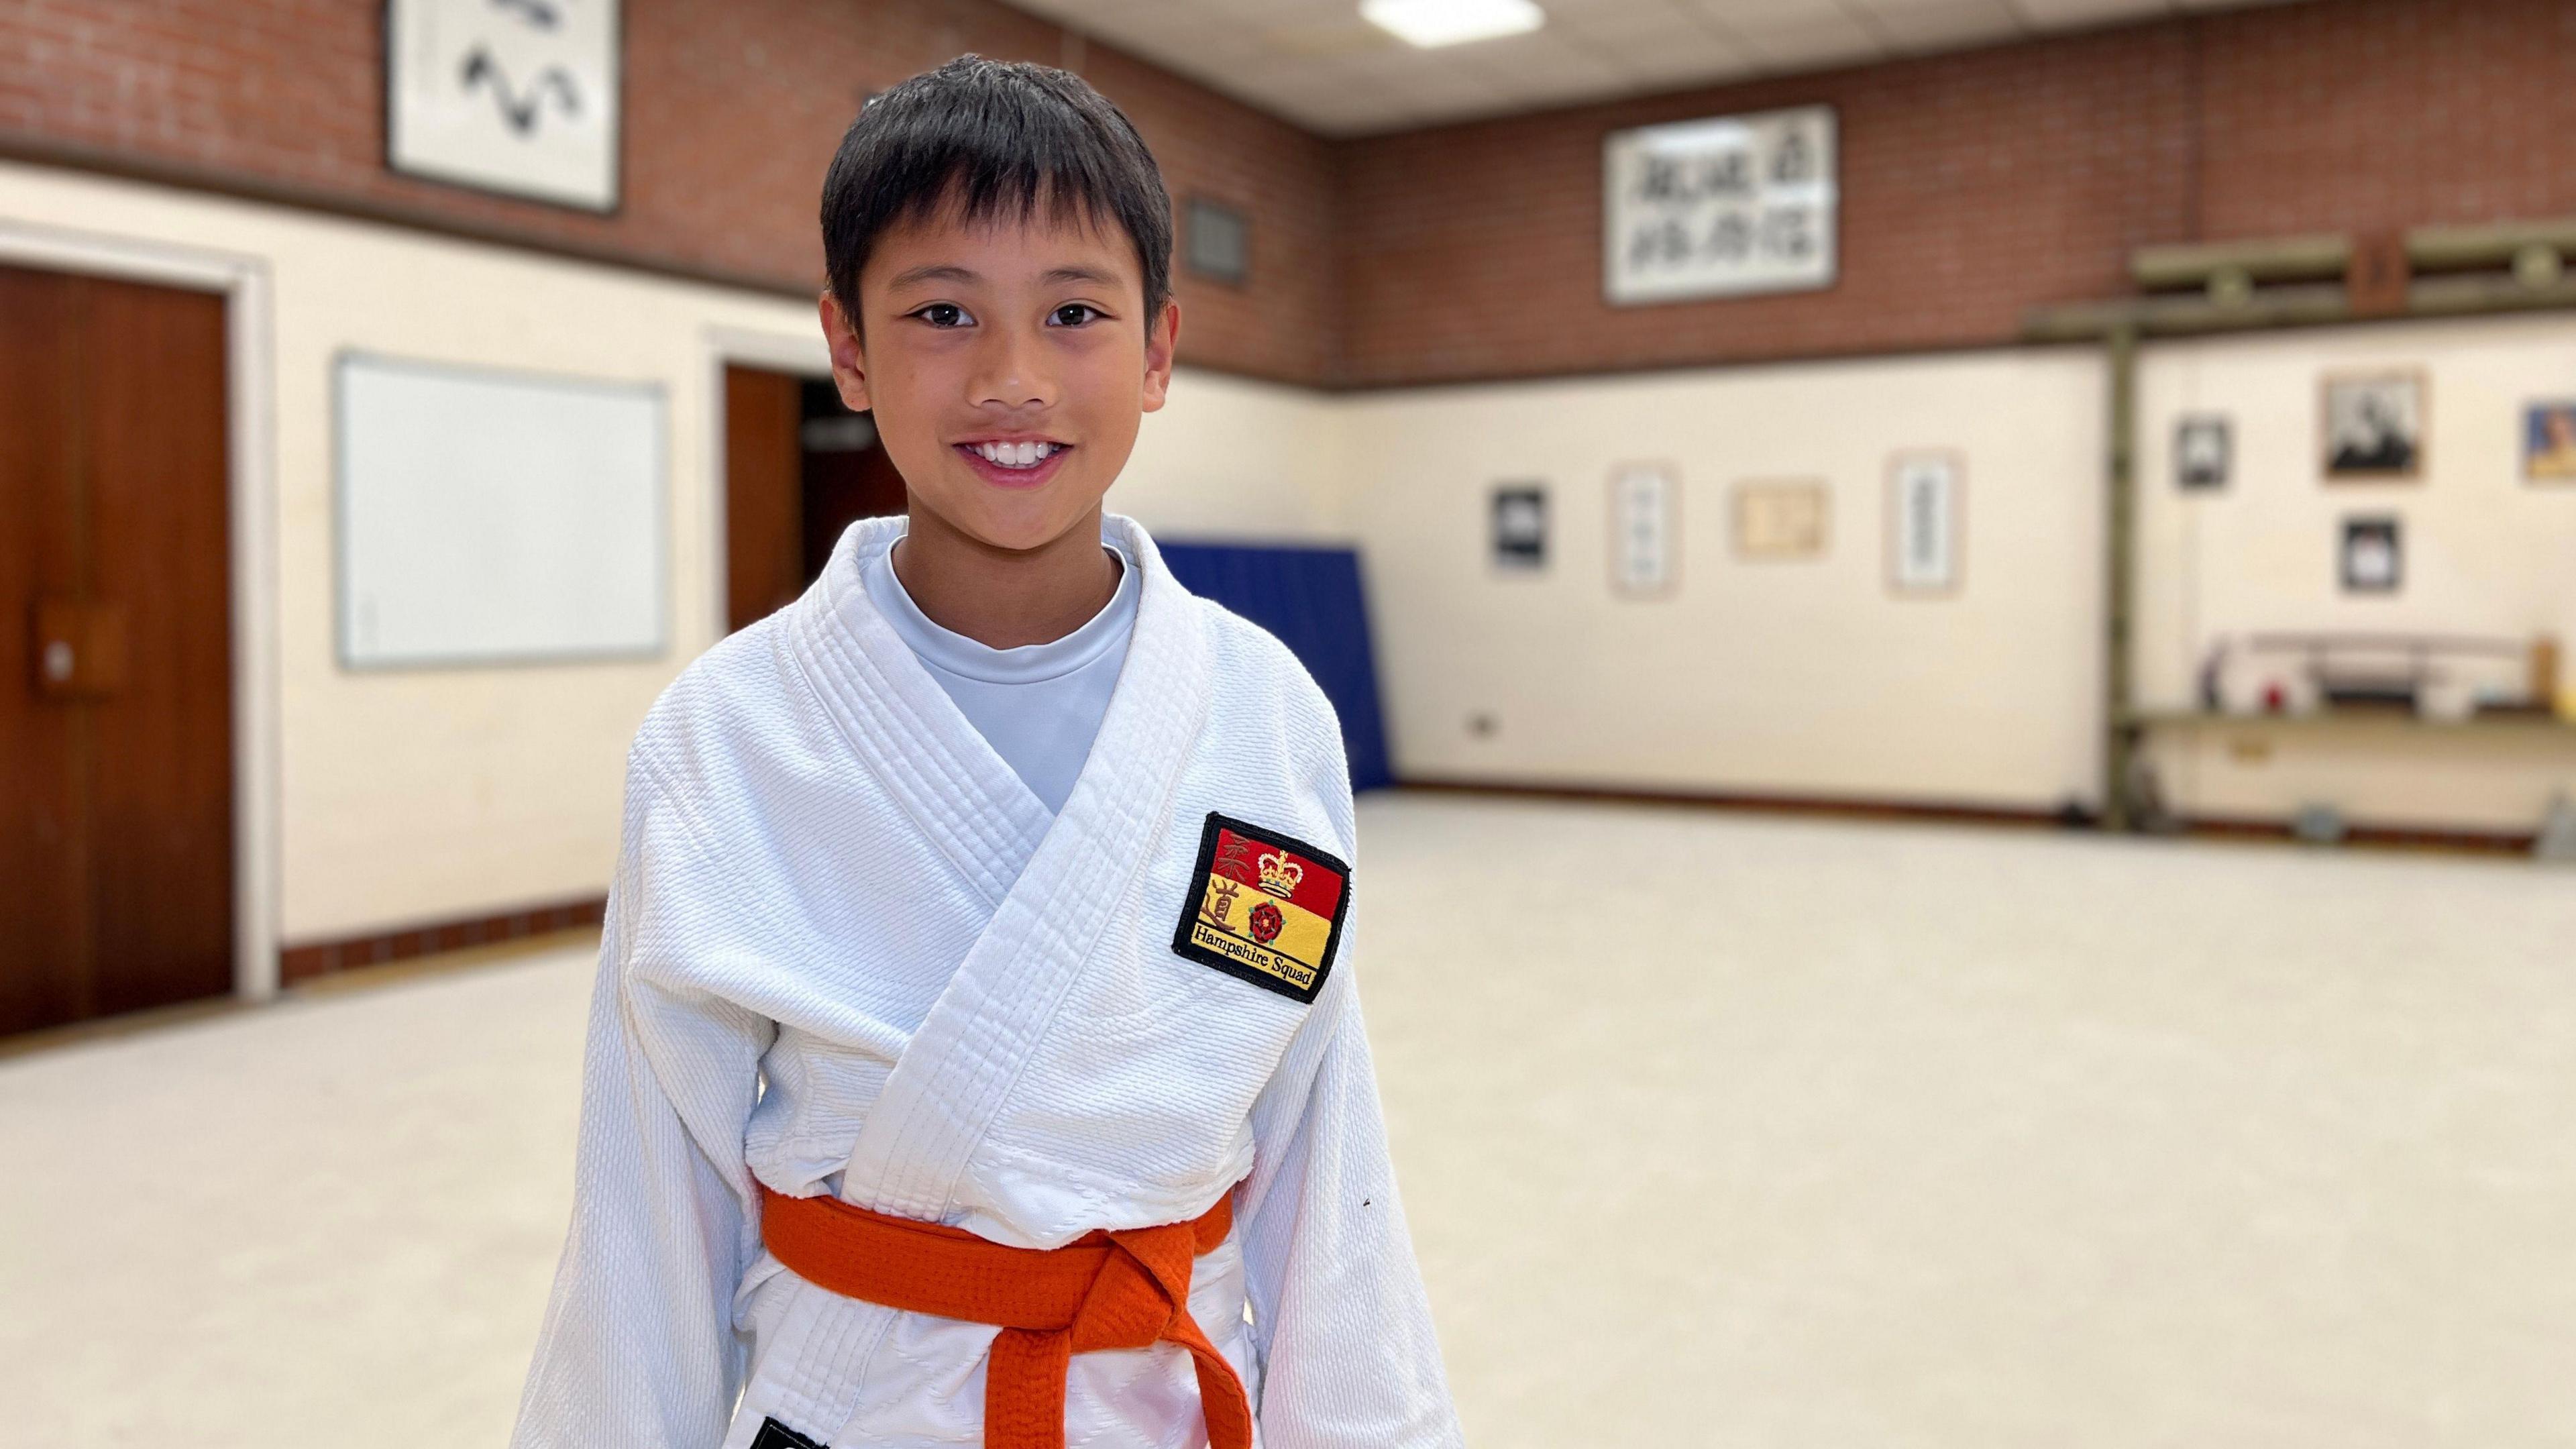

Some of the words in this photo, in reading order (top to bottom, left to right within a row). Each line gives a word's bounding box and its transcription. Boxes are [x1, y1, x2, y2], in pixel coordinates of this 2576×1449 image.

[1200, 834, 1250, 930] 柔道
[1195, 925, 1269, 966] Hampshire
[1271, 957, 1312, 985] Squad
